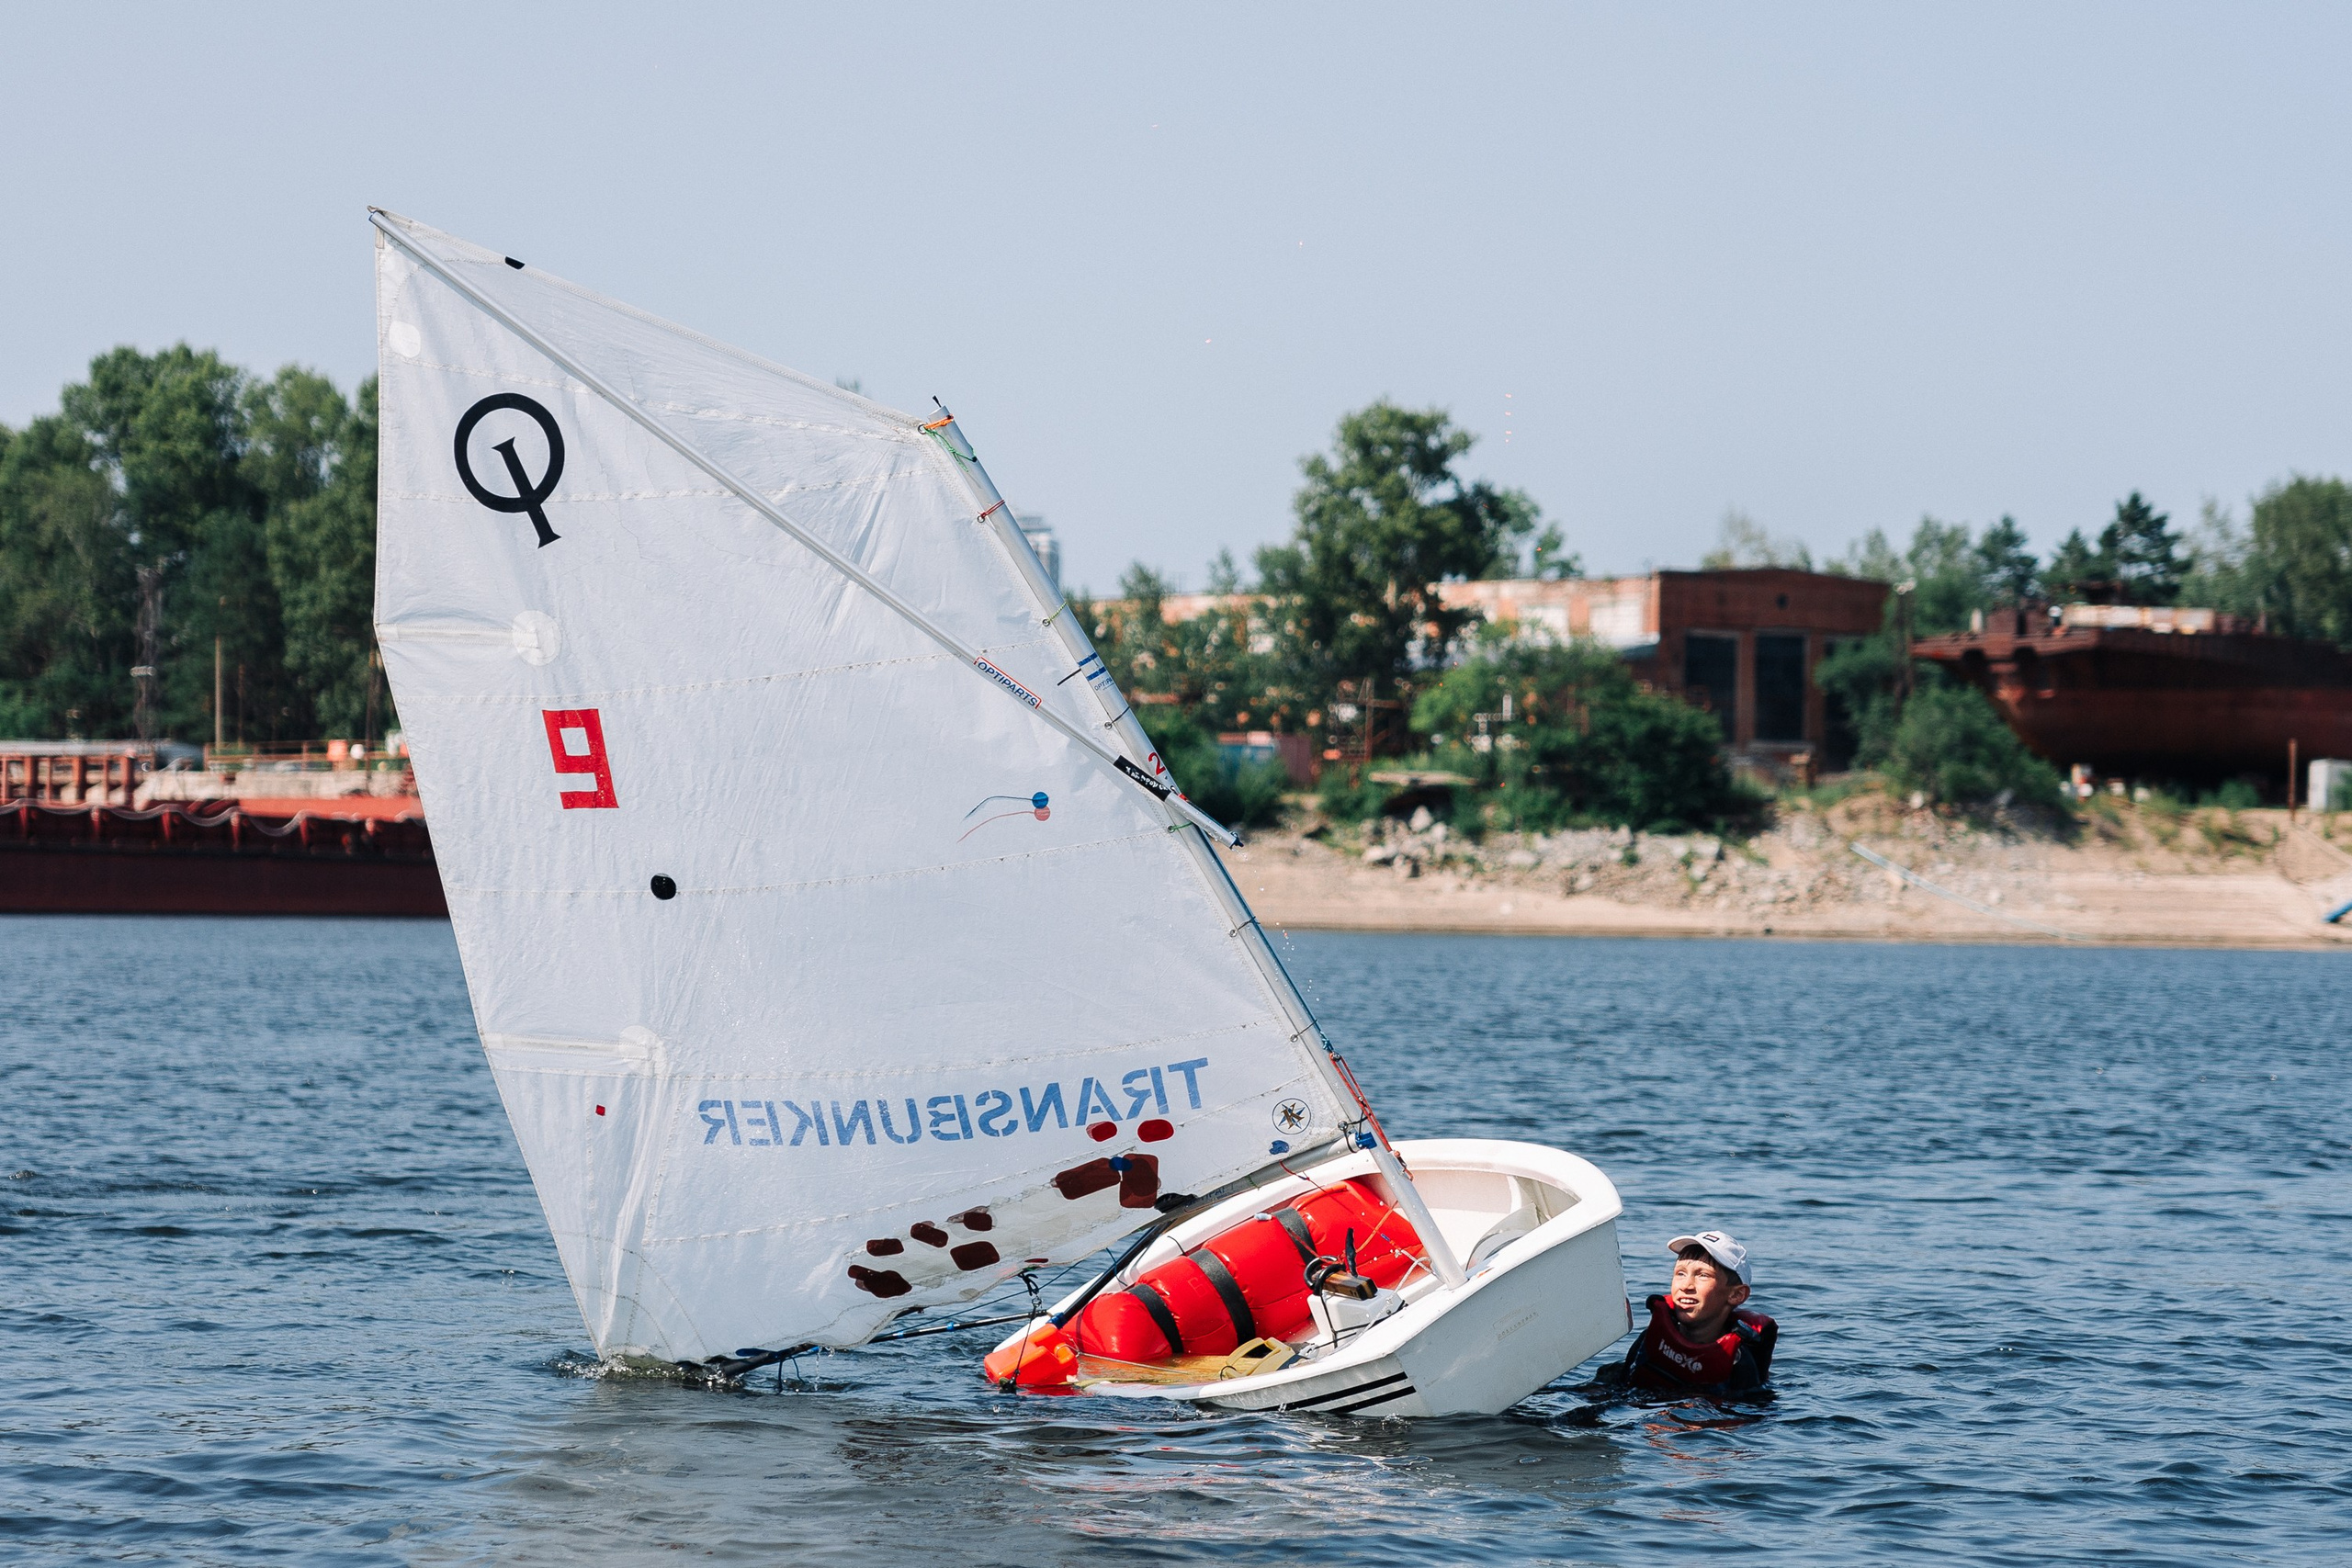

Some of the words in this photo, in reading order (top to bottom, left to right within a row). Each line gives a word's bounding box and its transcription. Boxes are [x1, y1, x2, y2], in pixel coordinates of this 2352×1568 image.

[978, 661, 1038, 706] OPTIPARTS
[542, 708, 619, 809] 9
[1148, 751, 1166, 776] 2
